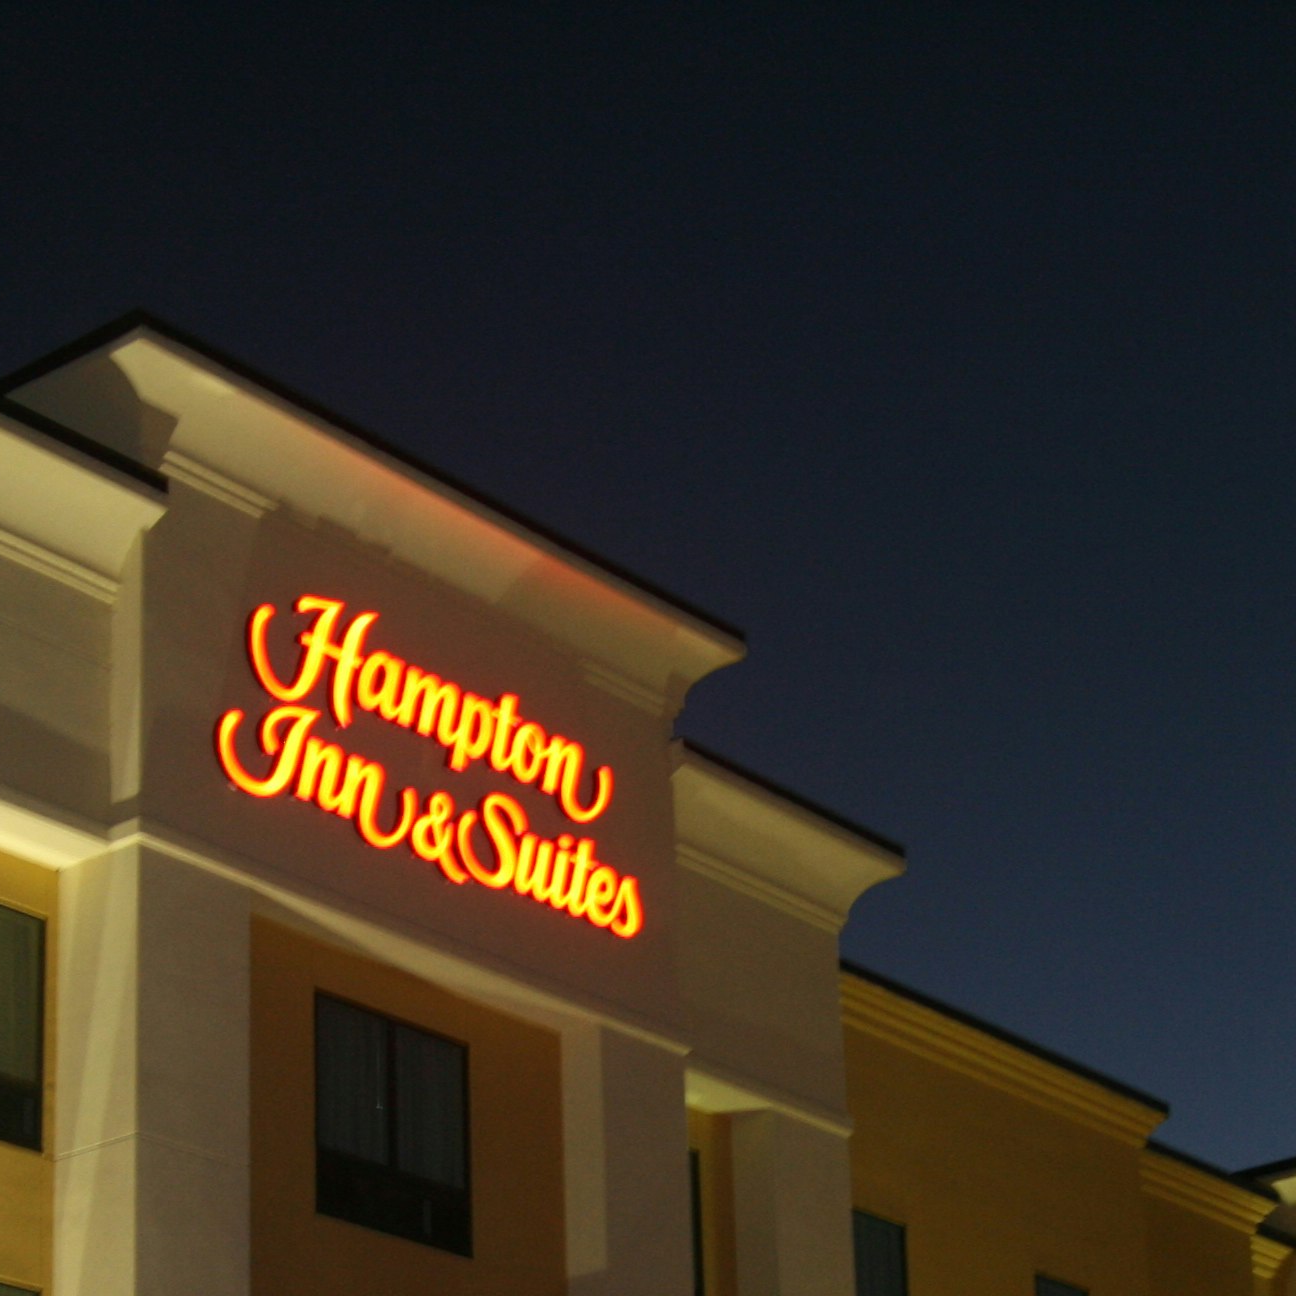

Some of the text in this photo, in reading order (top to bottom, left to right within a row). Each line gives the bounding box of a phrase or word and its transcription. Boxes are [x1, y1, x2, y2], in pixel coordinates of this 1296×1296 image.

[215, 703, 644, 939] Inn & Suites
[248, 594, 614, 824] Hampton
